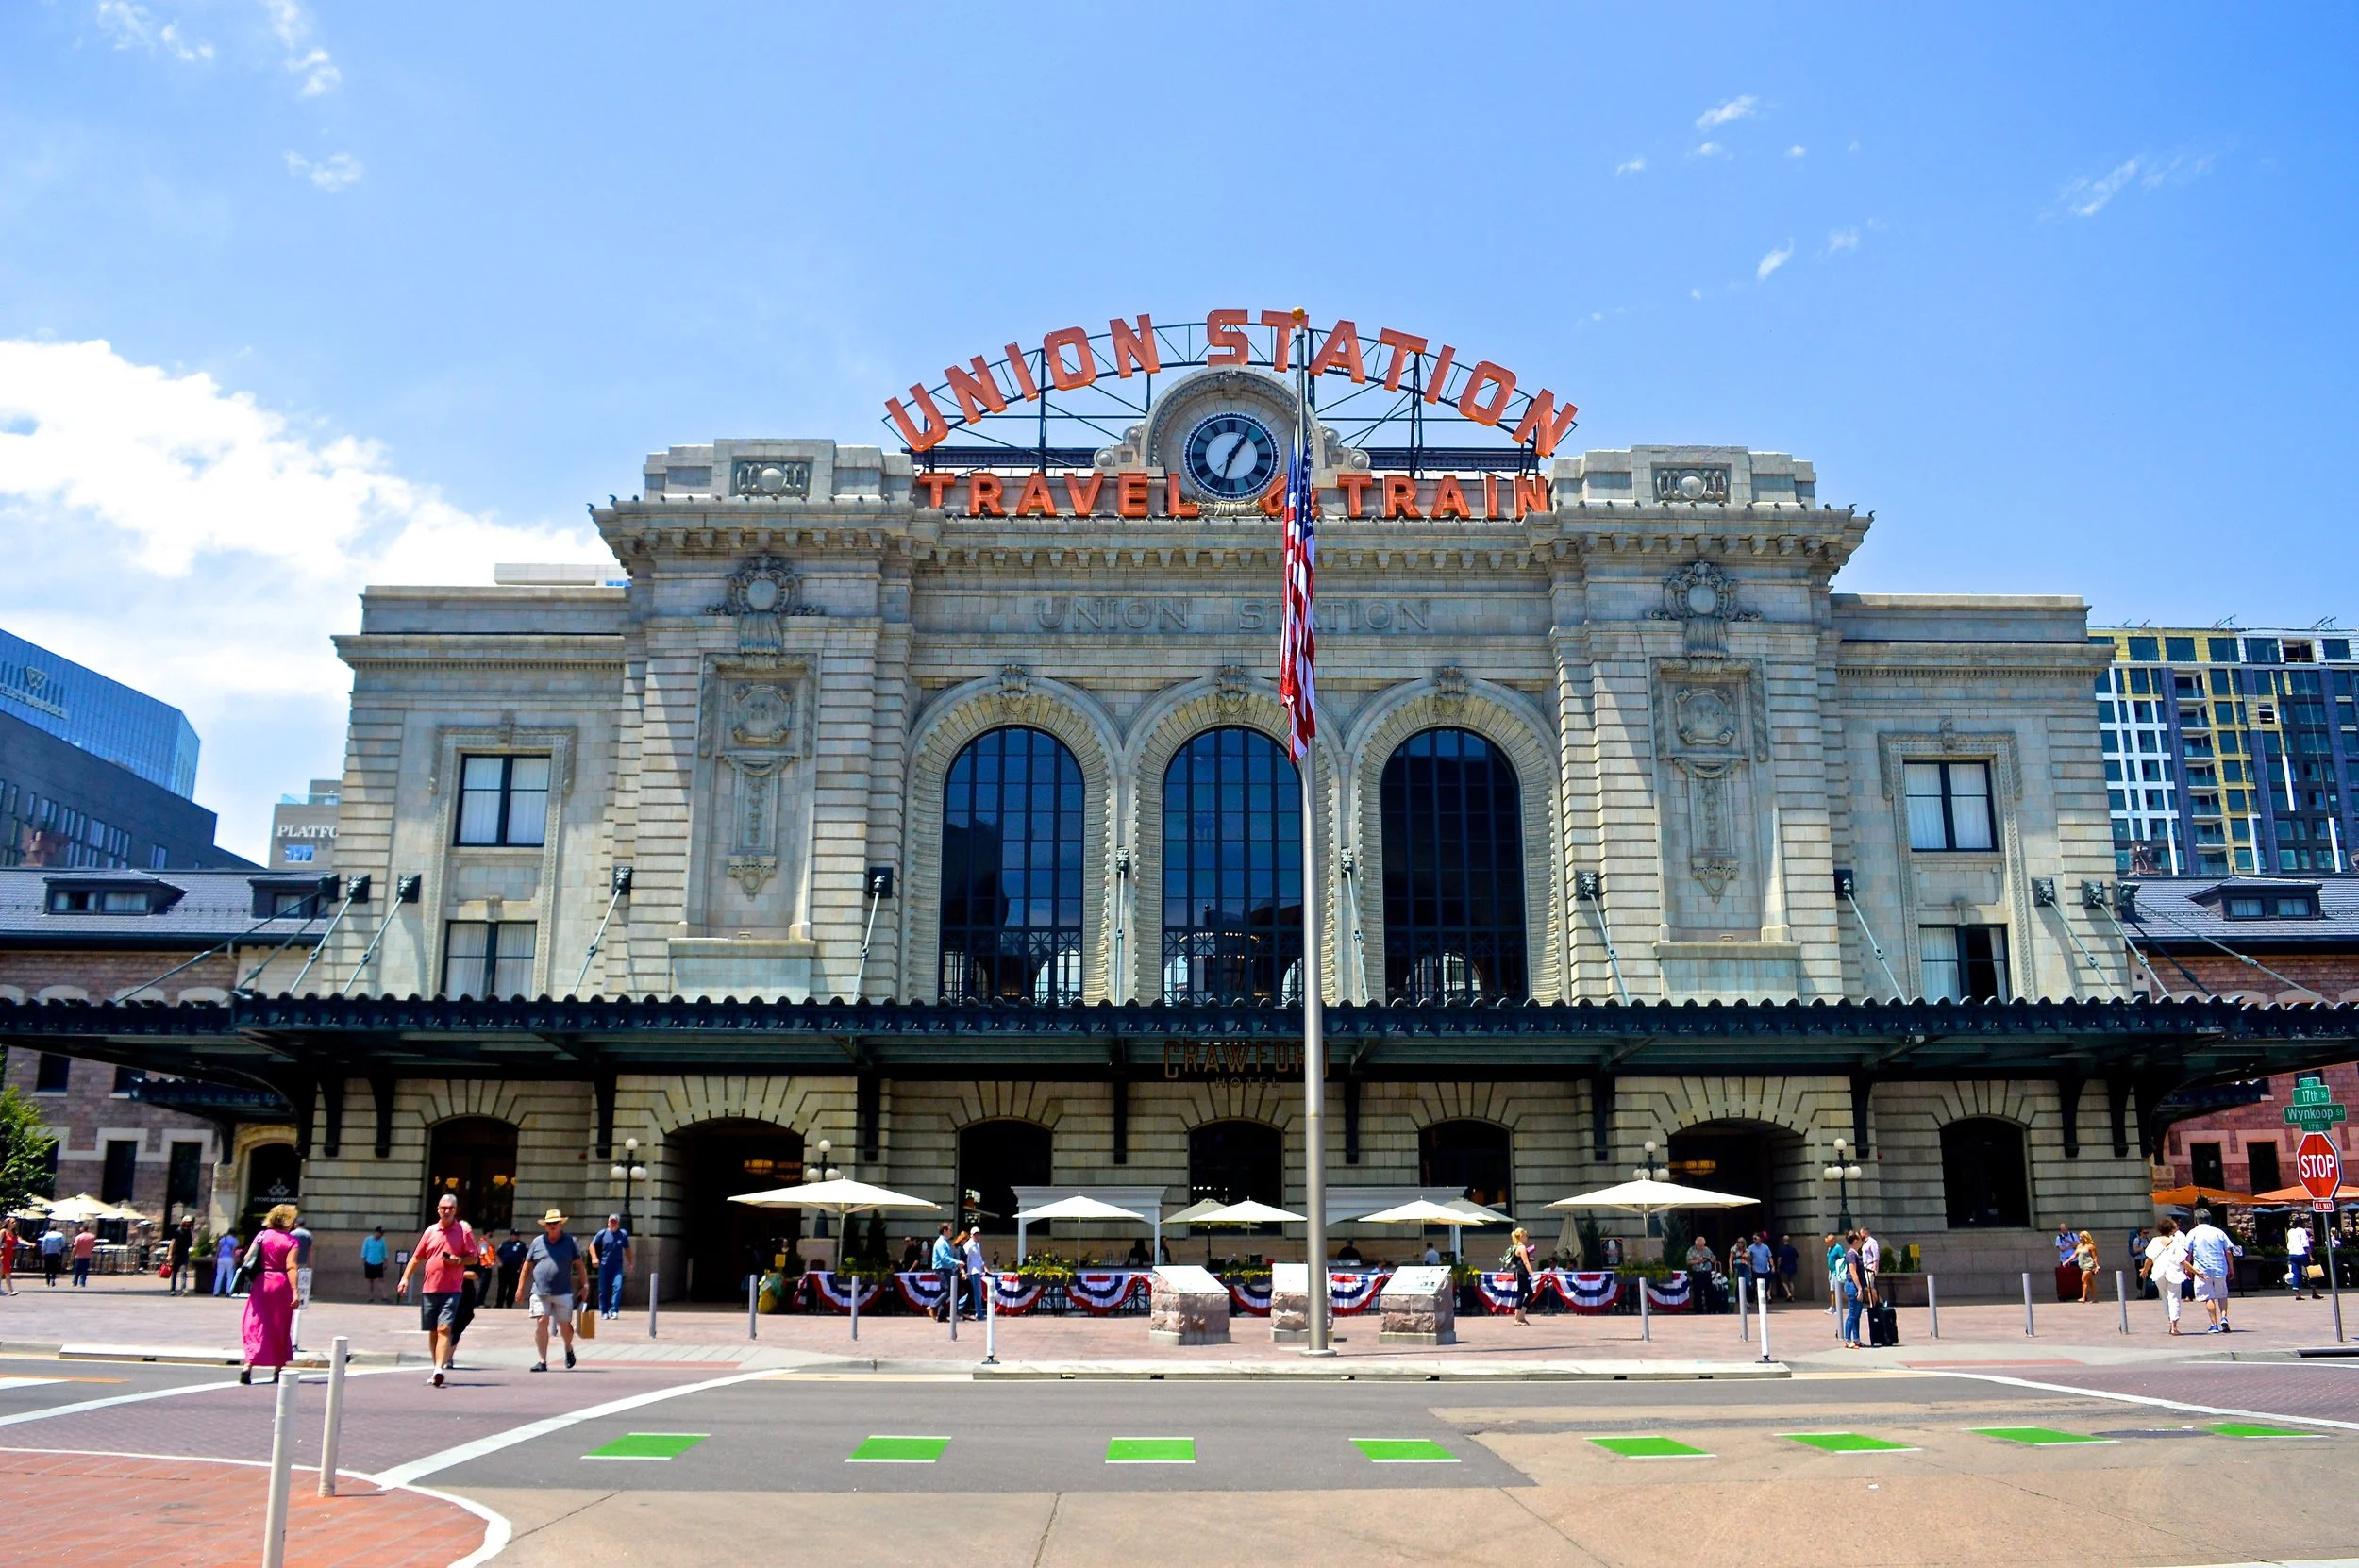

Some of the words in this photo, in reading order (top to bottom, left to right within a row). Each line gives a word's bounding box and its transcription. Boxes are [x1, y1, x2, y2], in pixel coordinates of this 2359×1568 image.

[885, 314, 1160, 451] UNION
[1207, 309, 1578, 459] STATION
[918, 473, 1199, 516] TRAVEL
[1336, 475, 1548, 519] TRAIN
[1037, 601, 1190, 630] UNION
[1215, 1077, 1280, 1089] HOTEL
[2302, 1090, 2318, 1102] 17th
[2286, 1108, 2334, 1122] Wynkoop
[2300, 1154, 2335, 1178] STOP
